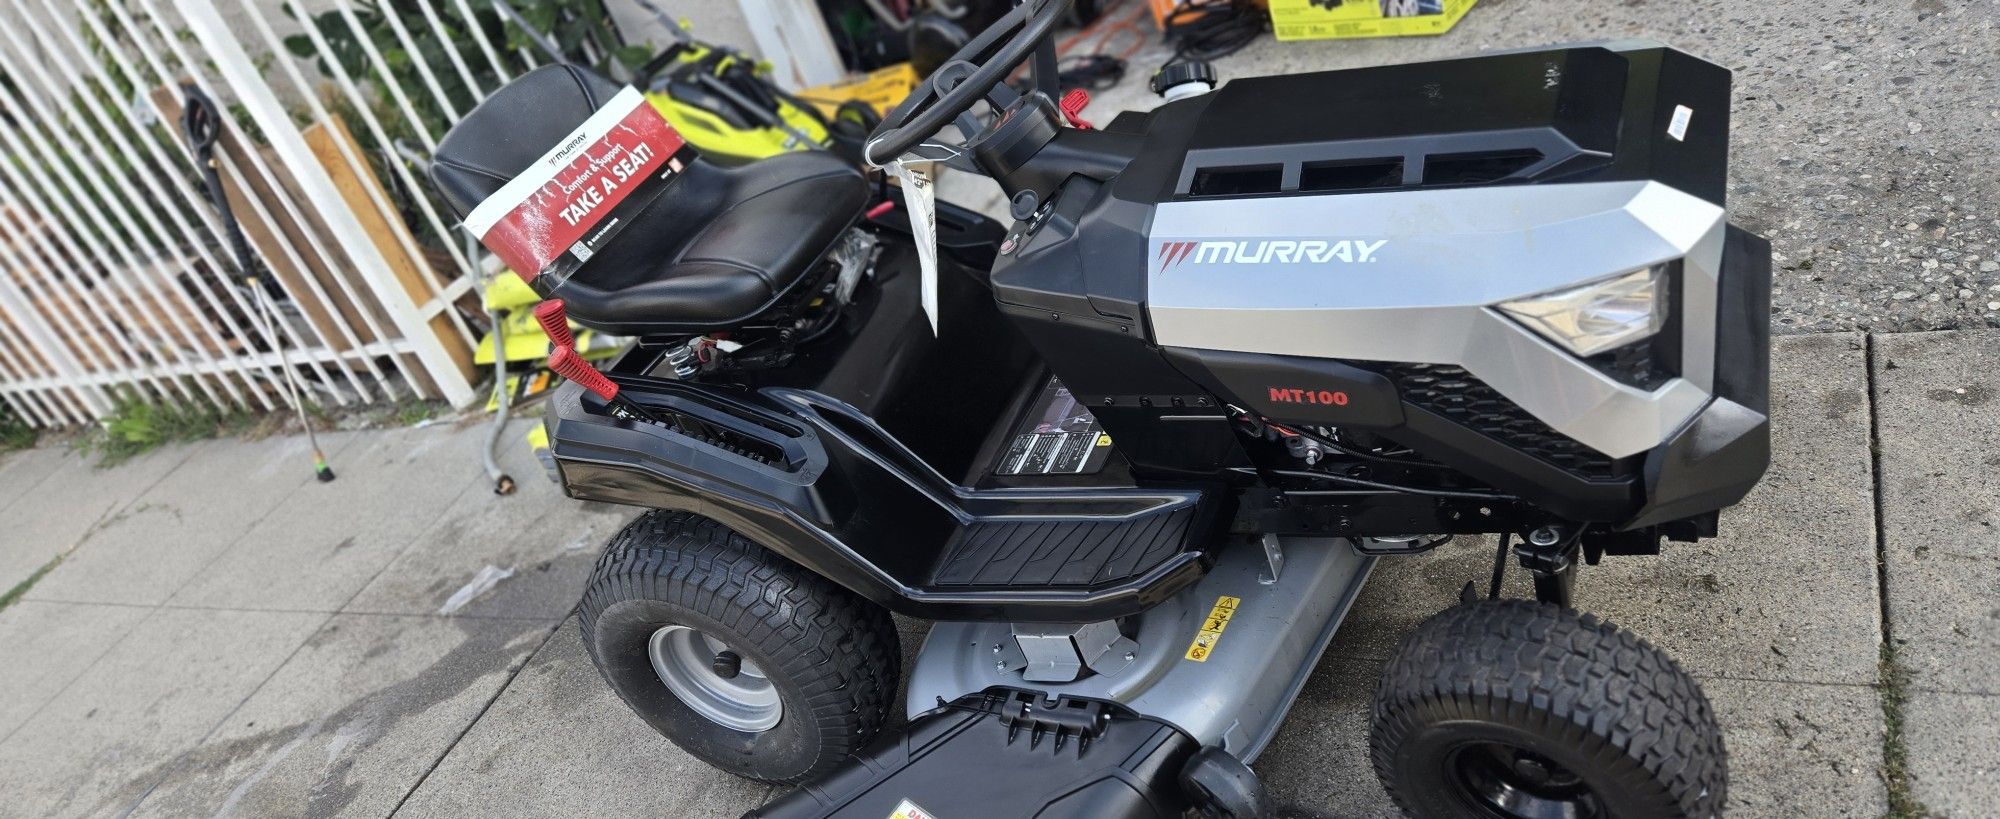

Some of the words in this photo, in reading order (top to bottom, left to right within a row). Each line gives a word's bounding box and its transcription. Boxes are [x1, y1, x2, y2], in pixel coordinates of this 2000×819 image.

[555, 132, 587, 160] MURRAY
[559, 186, 604, 227] TAKE
[600, 176, 618, 195] A
[612, 142, 655, 183] SEAT!
[563, 169, 593, 194] Comfort
[589, 163, 600, 173] &
[595, 143, 621, 166] Support
[1269, 387, 1348, 406] MT100
